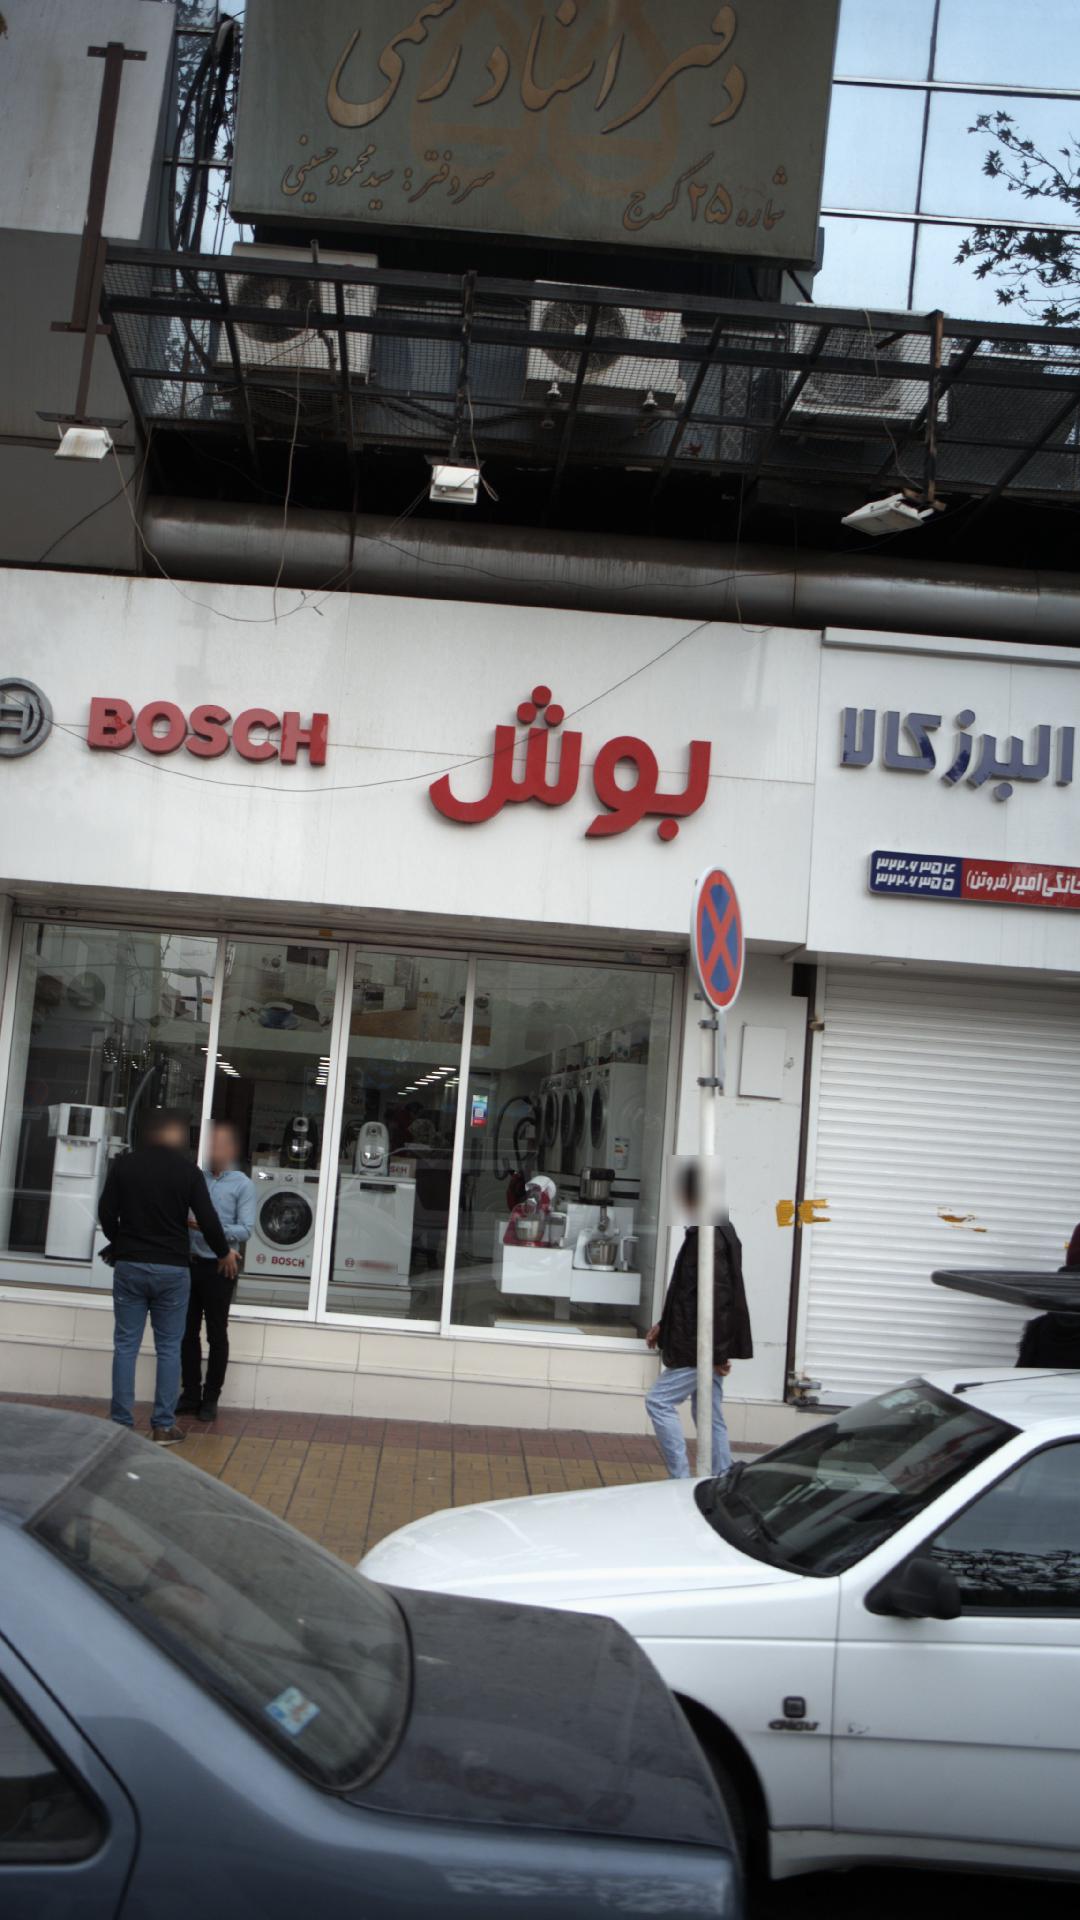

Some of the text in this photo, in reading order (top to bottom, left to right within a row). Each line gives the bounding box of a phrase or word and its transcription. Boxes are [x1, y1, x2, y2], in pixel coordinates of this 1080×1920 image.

[280, 134, 338, 203] حسینی
[326, 144, 377, 187] محمود
[622, 151, 715, 231] کرج
[687, 182, 734, 225] ۲۵
[87, 696, 329, 766] BOSCH
[428, 685, 712, 842] بوش
[1011, 872, 1043, 896] امیر
[271, 1256, 305, 1268] BOSCH
